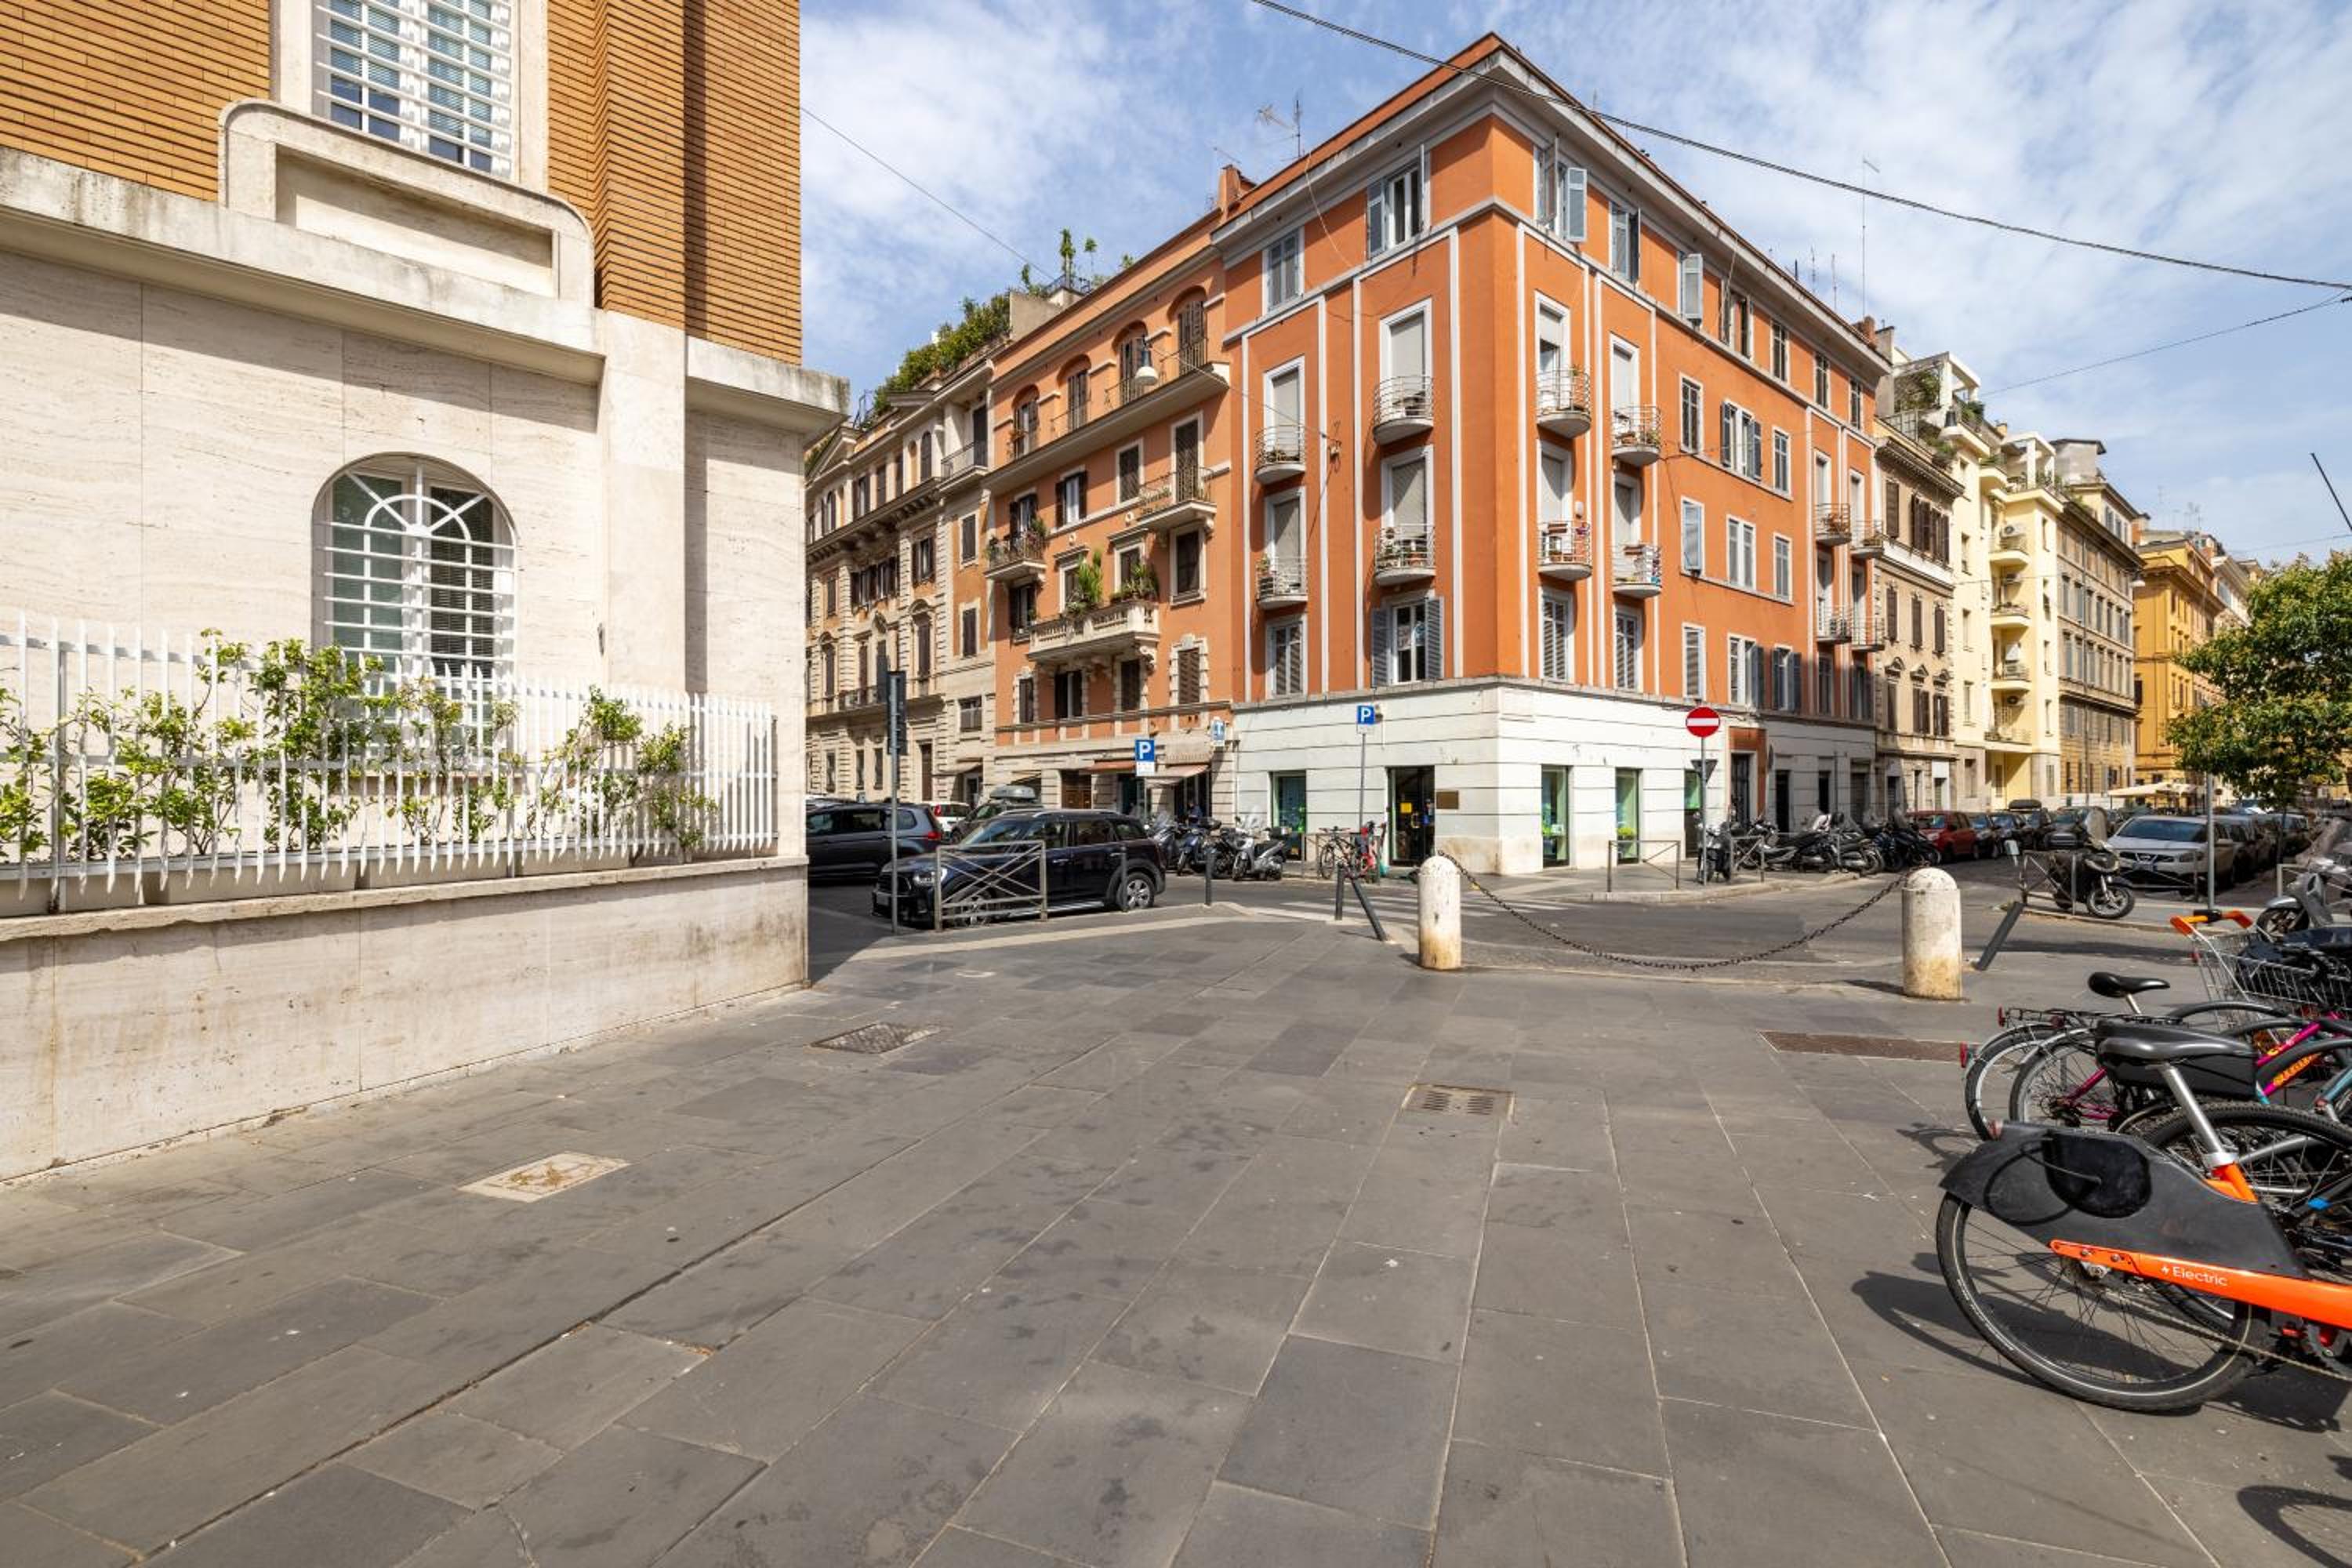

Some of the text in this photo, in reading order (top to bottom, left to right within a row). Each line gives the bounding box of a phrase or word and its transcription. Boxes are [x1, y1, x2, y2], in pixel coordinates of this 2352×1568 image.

[1360, 707, 1371, 722] P
[1139, 742, 1152, 760] P
[2172, 1266, 2228, 1286] Electric
